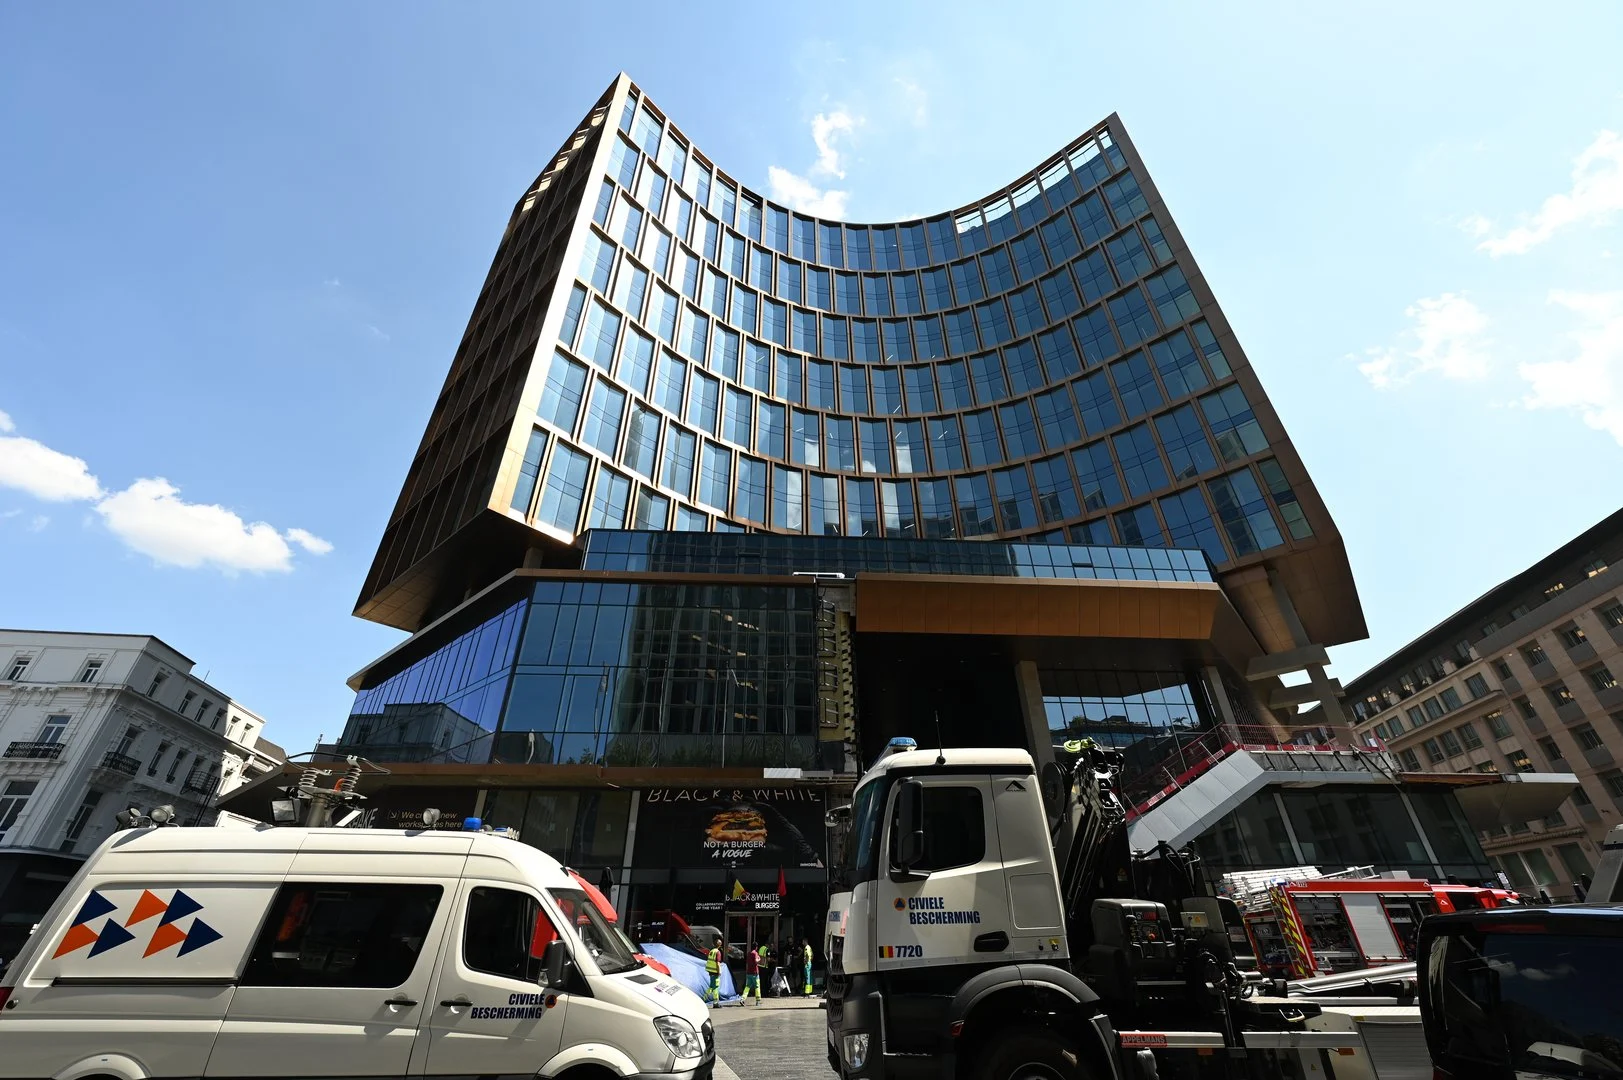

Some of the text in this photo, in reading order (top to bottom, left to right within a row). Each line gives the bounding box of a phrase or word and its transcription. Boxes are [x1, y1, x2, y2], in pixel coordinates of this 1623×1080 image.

[647, 789, 721, 802] BLACK
[732, 789, 744, 801] &
[401, 811, 414, 819] We
[398, 820, 462, 829] workses here
[703, 840, 721, 849] NOT
[722, 840, 730, 849] A
[711, 849, 753, 858] A VOGUE
[908, 897, 944, 910] CIVIELE
[909, 911, 980, 924] BESCHERMING
[895, 945, 923, 958] 7720
[508, 993, 546, 1006] CIVIELE
[470, 1006, 543, 1020] BESCHERMING
[1122, 1035, 1165, 1044] APPELMANS
